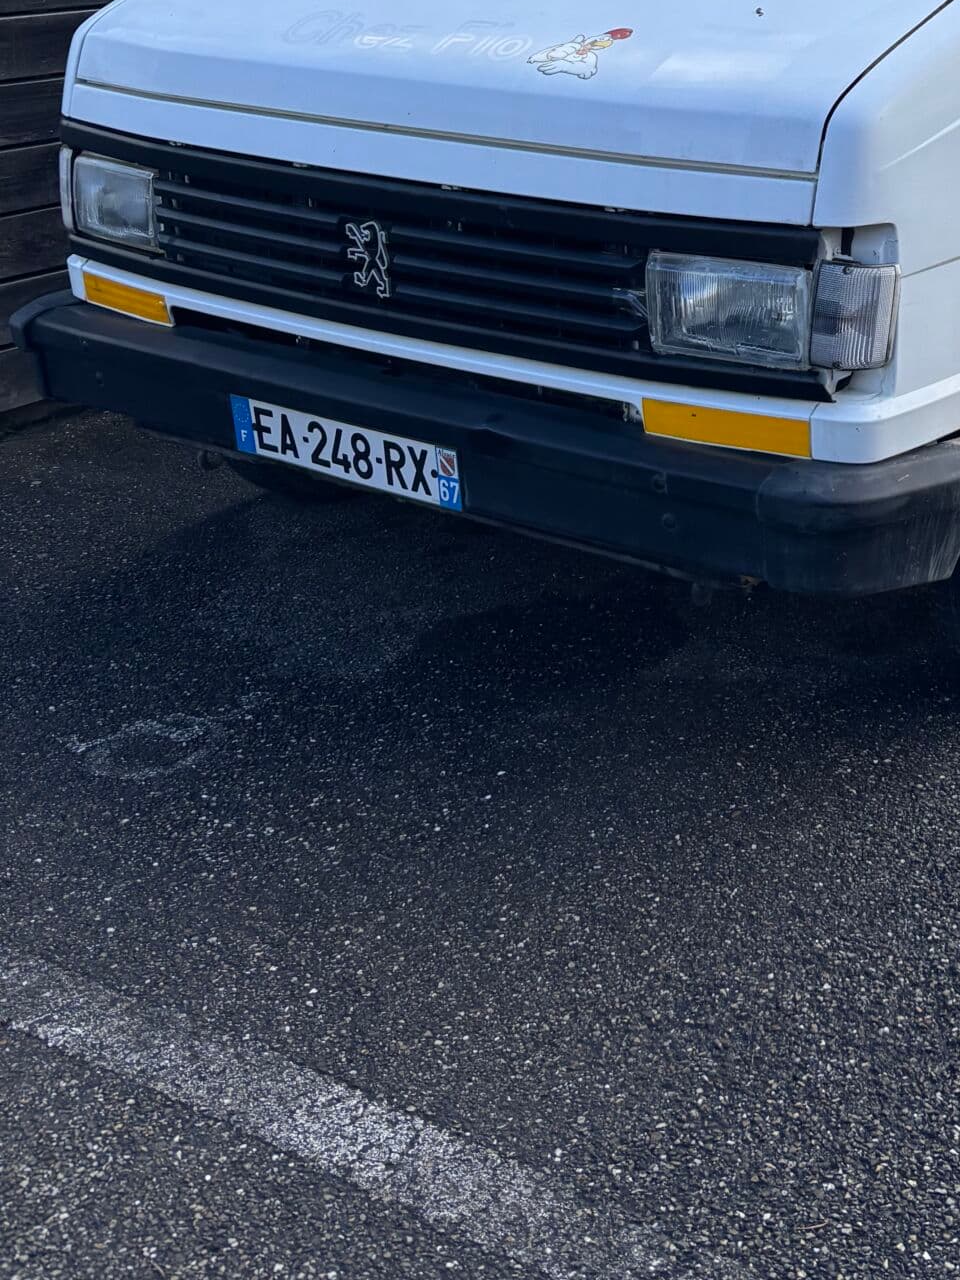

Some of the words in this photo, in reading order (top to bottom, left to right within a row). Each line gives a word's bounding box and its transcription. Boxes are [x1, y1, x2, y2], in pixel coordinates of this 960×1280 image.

[240, 430, 248, 442] F
[252, 406, 432, 496] EA-248-RX
[440, 479, 459, 504] 67
